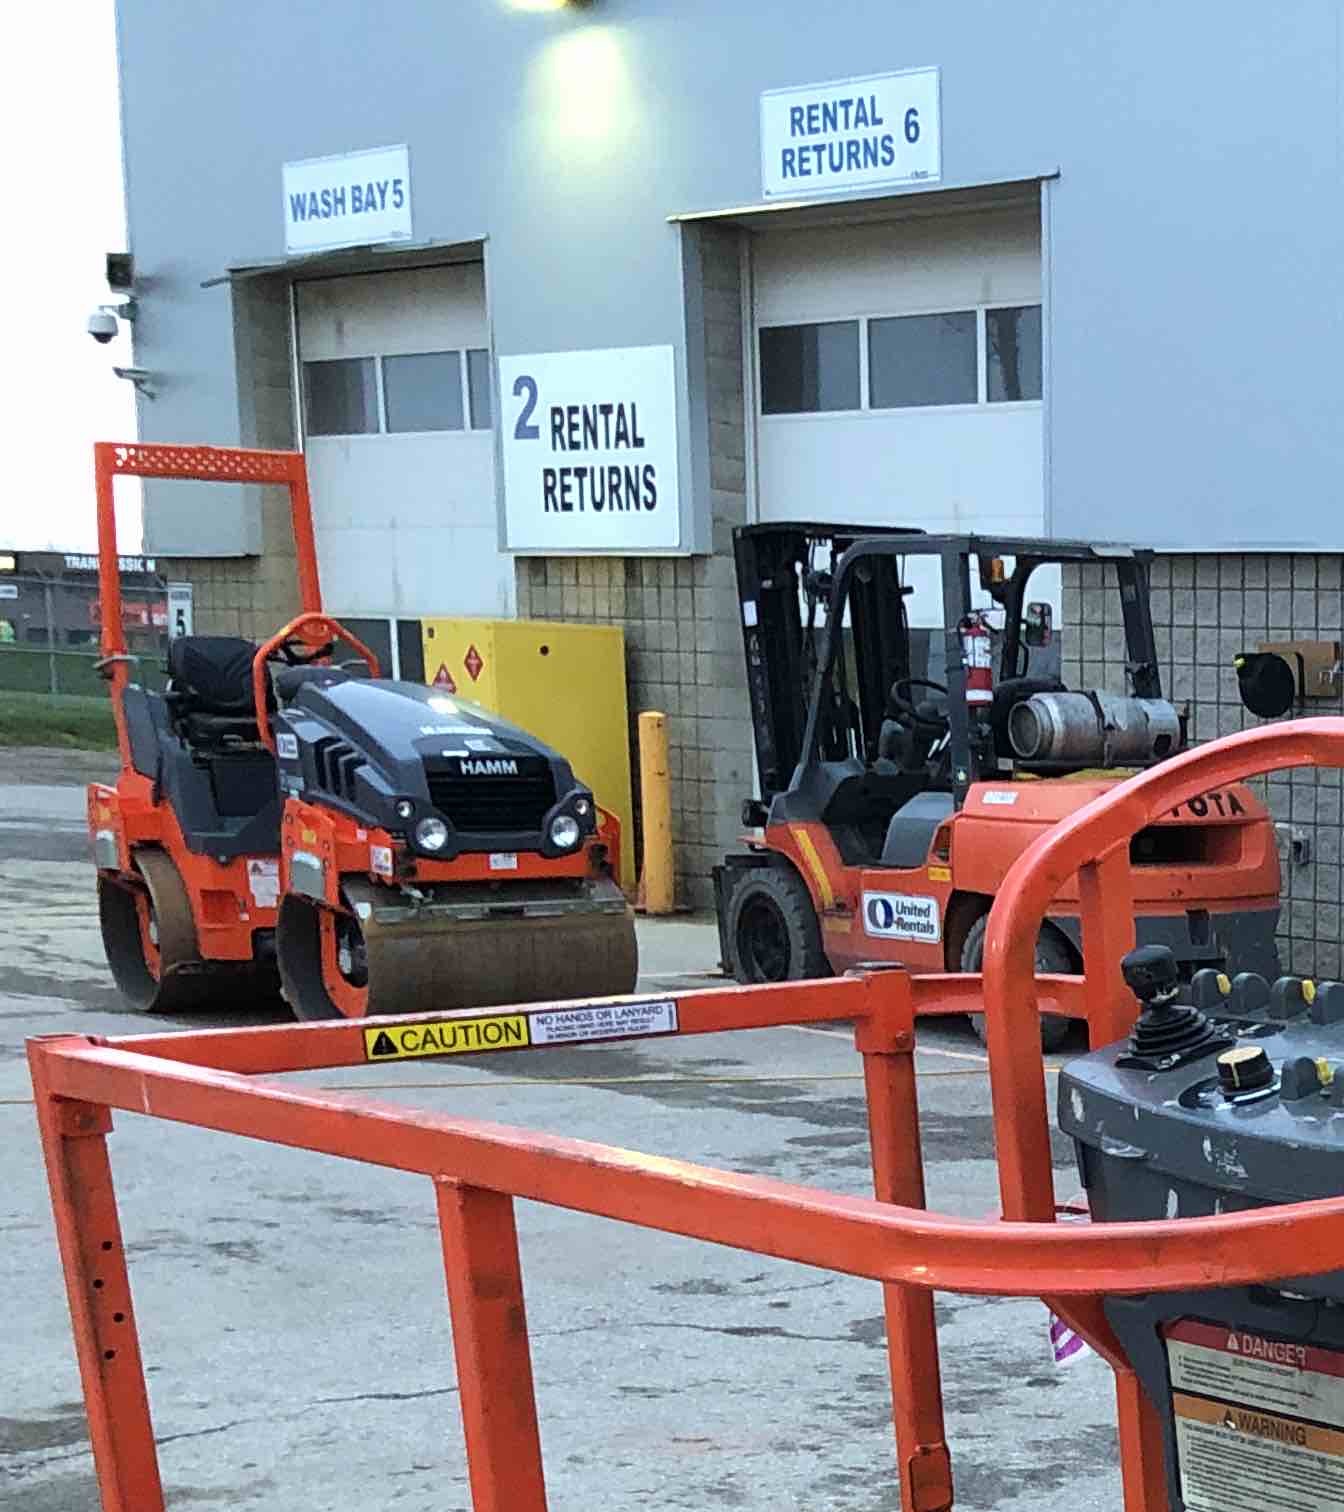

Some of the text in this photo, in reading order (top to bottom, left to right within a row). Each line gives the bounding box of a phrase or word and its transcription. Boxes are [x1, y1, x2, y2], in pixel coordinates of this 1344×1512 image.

[790, 94, 883, 137] RENTAL
[904, 107, 920, 144] 6
[782, 134, 895, 179] RETURNS
[290, 178, 404, 222] WASH BAY 5
[512, 375, 540, 440] 2
[550, 402, 645, 452] RENTAL
[543, 464, 657, 513] RETURNS
[460, 760, 518, 775] HAMM
[896, 900, 931, 918] United
[896, 918, 934, 934] Rentals
[536, 1006, 664, 1026] NO HANDS OR LANYARD
[400, 1020, 521, 1051] CAUTION
[1242, 1335, 1307, 1367] DANGER
[1238, 1411, 1307, 1446] WARNING
